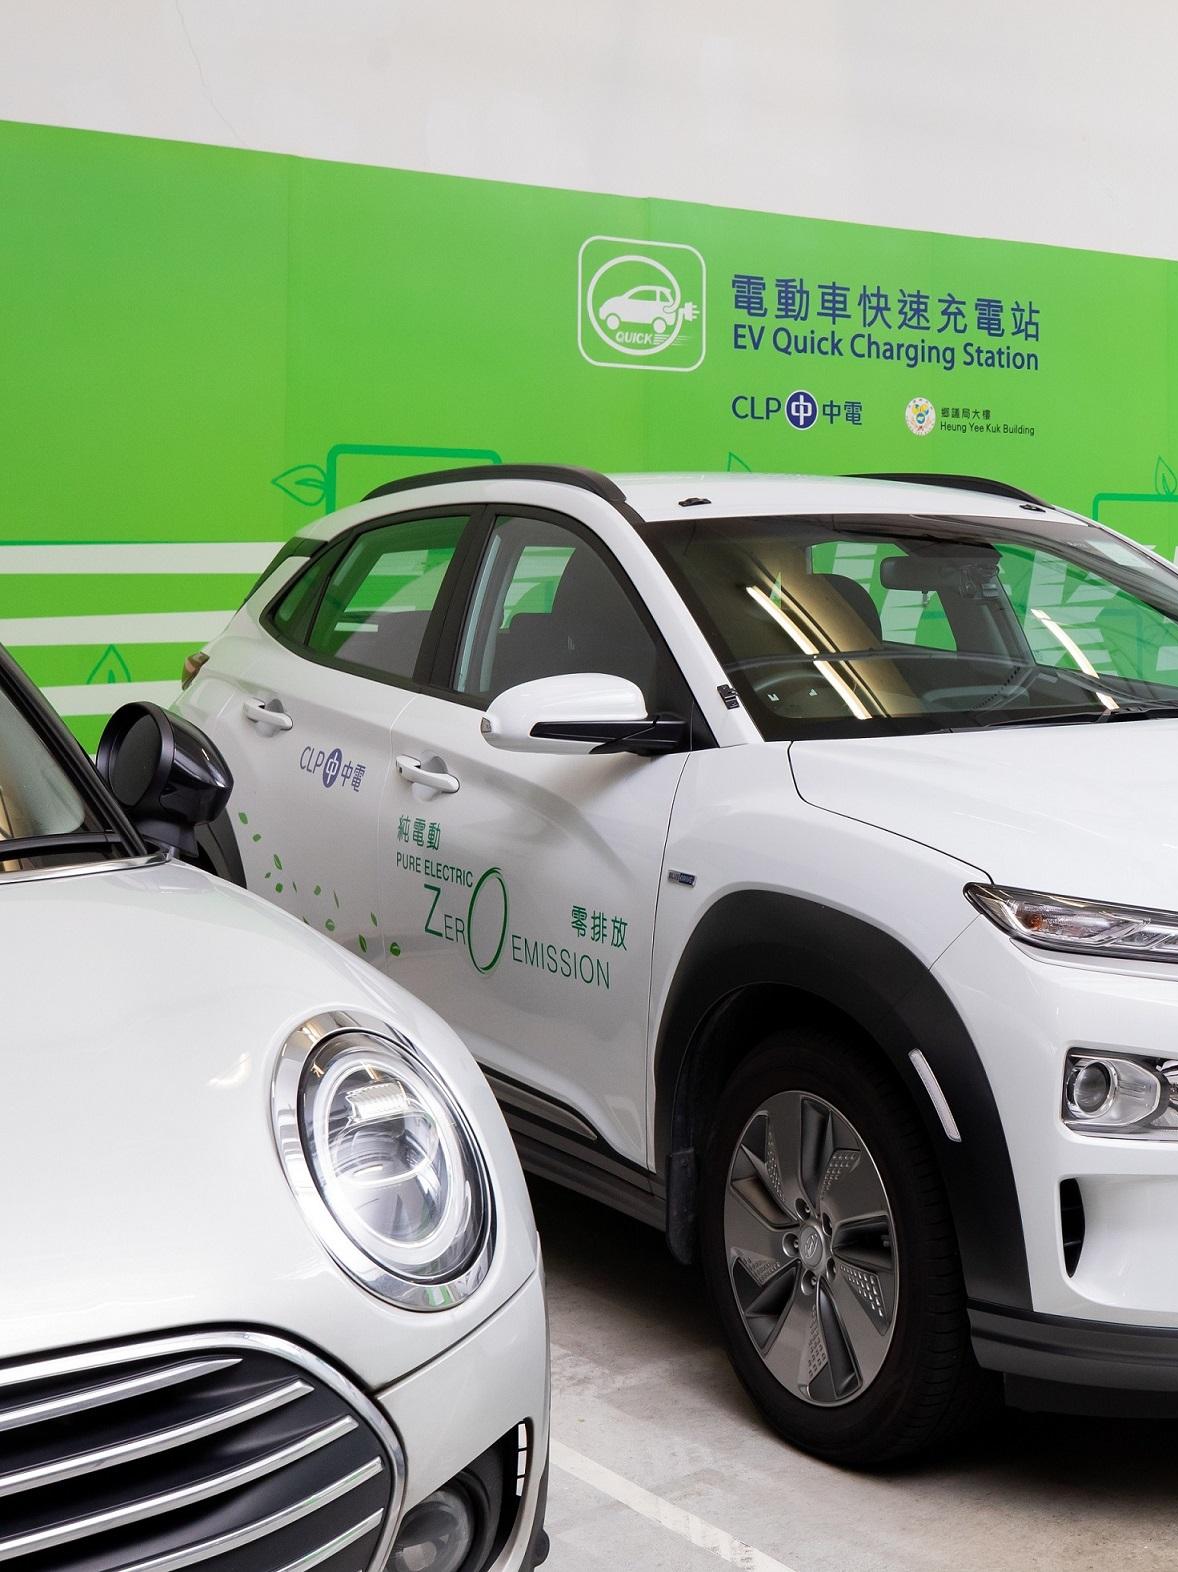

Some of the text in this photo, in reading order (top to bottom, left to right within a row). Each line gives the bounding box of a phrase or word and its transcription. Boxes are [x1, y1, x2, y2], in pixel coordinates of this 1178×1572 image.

[731, 274, 1040, 342] 電動車快速充電站
[616, 330, 653, 344] QUICK
[733, 324, 1039, 371] EV Quick Charging Station
[731, 395, 782, 420] CLP
[822, 399, 863, 426] 中電
[940, 422, 1035, 437] Heung Yee Kuk Building
[299, 745, 324, 775] CLP
[341, 763, 367, 793] 中電
[397, 814, 442, 851] 純電動
[396, 852, 474, 888] PURE ELECTRIC
[570, 905, 628, 951] 零排放
[511, 935, 611, 990] EMISSION
